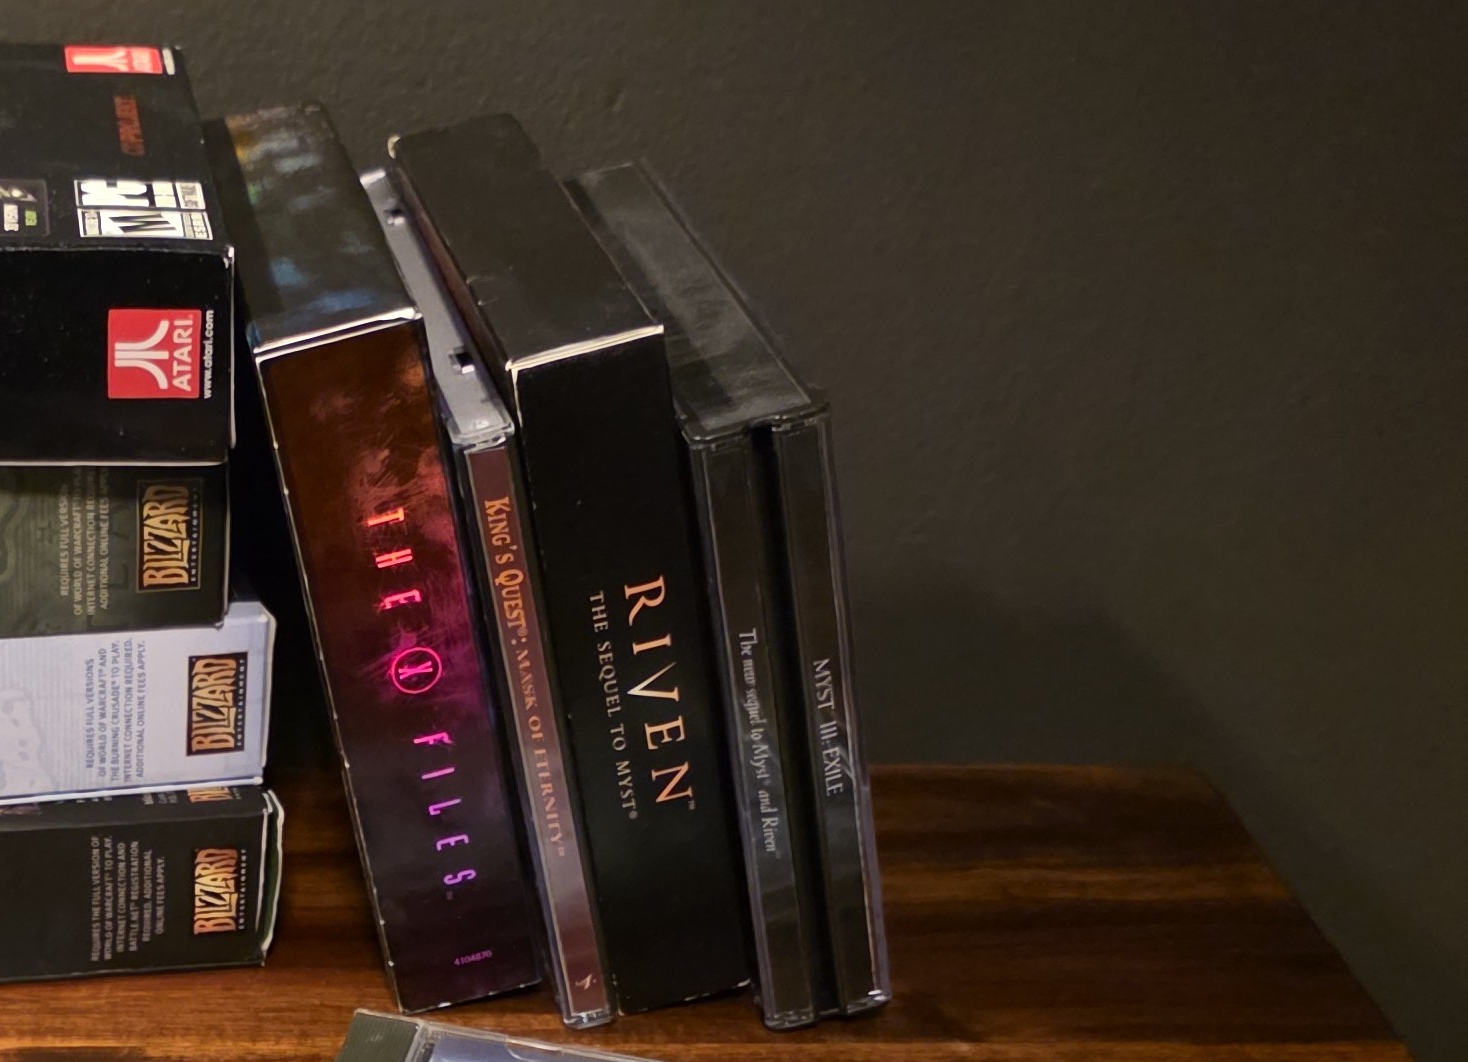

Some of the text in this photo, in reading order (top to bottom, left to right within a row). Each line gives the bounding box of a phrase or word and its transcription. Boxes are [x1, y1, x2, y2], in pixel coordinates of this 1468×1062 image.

[172, 319, 194, 393] ATARI
[202, 309, 215, 400] www.atari.com
[59, 528, 70, 549] FULL
[99, 520, 109, 556] ONLINE
[143, 485, 189, 587] BLIZZARD
[73, 571, 83, 602] WORLD
[86, 574, 97, 616] INTERNET
[99, 557, 109, 609] ADDITIONAL
[485, 495, 518, 565] KING'S
[515, 648, 538, 711] MASK
[527, 714, 544, 740] OF
[589, 590, 610, 633] THE
[97, 648, 107, 667] AND
[110, 640, 120, 665] PLAY.
[738, 628, 759, 657] The
[110, 667, 120, 678] TO
[597, 640, 622, 718] SEQUEL
[624, 574, 693, 804] RIVEN
[812, 658, 836, 710] MYST
[85, 658, 95, 769] REQUIRES FULL VERSIONS
[123, 638, 133, 783] INTERNET CONNECTION REQUIRED.
[136, 640, 146, 778] ADDITIONAL ONLINE FEES APPLY.
[191, 658, 237, 753] BLIZZARD
[236, 658, 245, 747] ENTERTAINMENT
[367, 507, 422, 610] THE
[413, 731, 477, 886] FILES
[743, 688, 768, 726] sequel
[98, 722, 107, 732] OF
[110, 727, 120, 765] BURNING
[609, 723, 628, 752] TO
[749, 728, 765, 741] to
[98, 734, 107, 765] WORLD
[98, 766, 107, 777] OF
[110, 767, 120, 782] THE
[821, 746, 845, 798] EXILE
[757, 789, 779, 814] and
[104, 835, 113, 858] PLAY.
[760, 815, 780, 853] Riven
[104, 859, 113, 871] TO
[129, 841, 139, 900] REGISTRATION
[142, 849, 152, 899] ADDITIONAL
[91, 836, 101, 961] REQUIRES THE FULL VERSION OF
[116, 842, 127, 952] INTERNET CONNECTION AND
[155, 856, 165, 935] ONLINE FEES APPLY.
[193, 848, 238, 936] BLIZZARD
[104, 920, 113, 930] OF
[104, 931, 114, 961] WORLD
